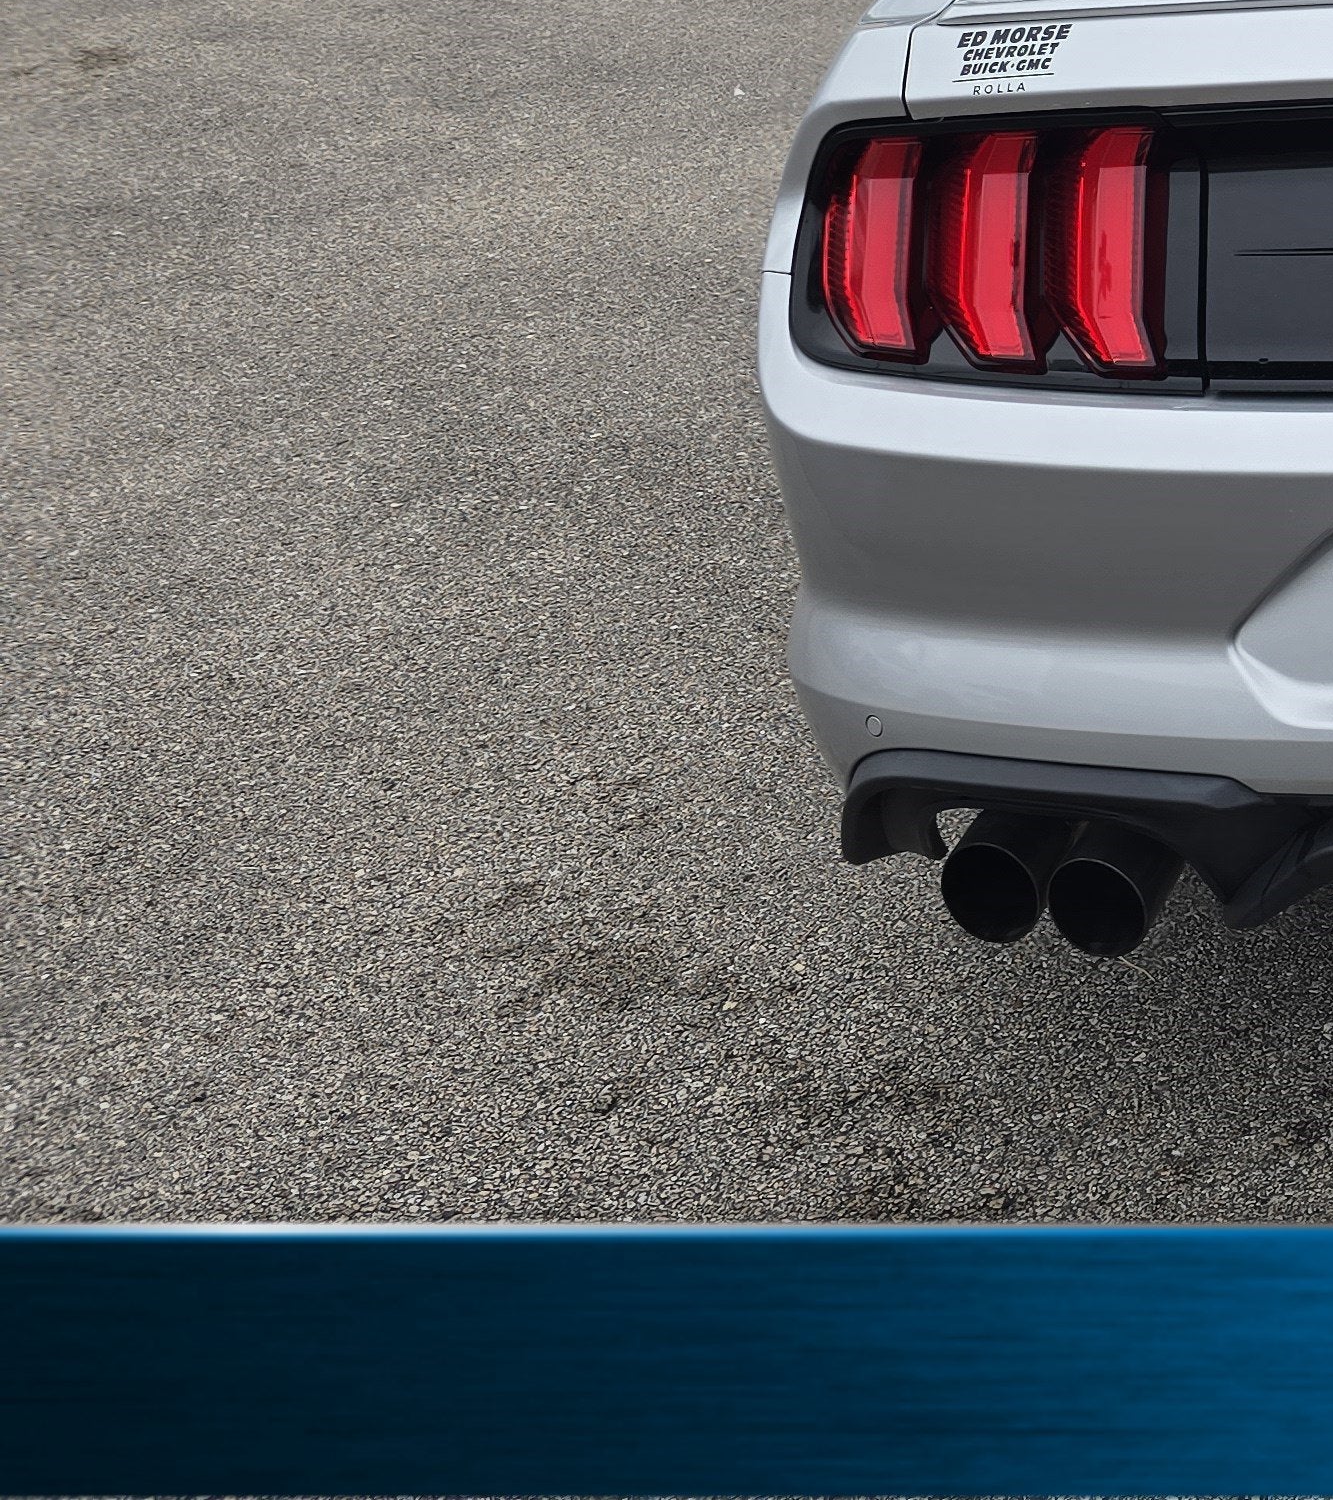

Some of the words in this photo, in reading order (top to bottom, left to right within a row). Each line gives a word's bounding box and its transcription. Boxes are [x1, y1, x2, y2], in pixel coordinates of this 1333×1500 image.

[957, 31, 988, 48] ED
[990, 24, 1073, 46] MORSE
[963, 42, 1060, 62] CHEVROLET
[973, 82, 1026, 96] ROLLA
